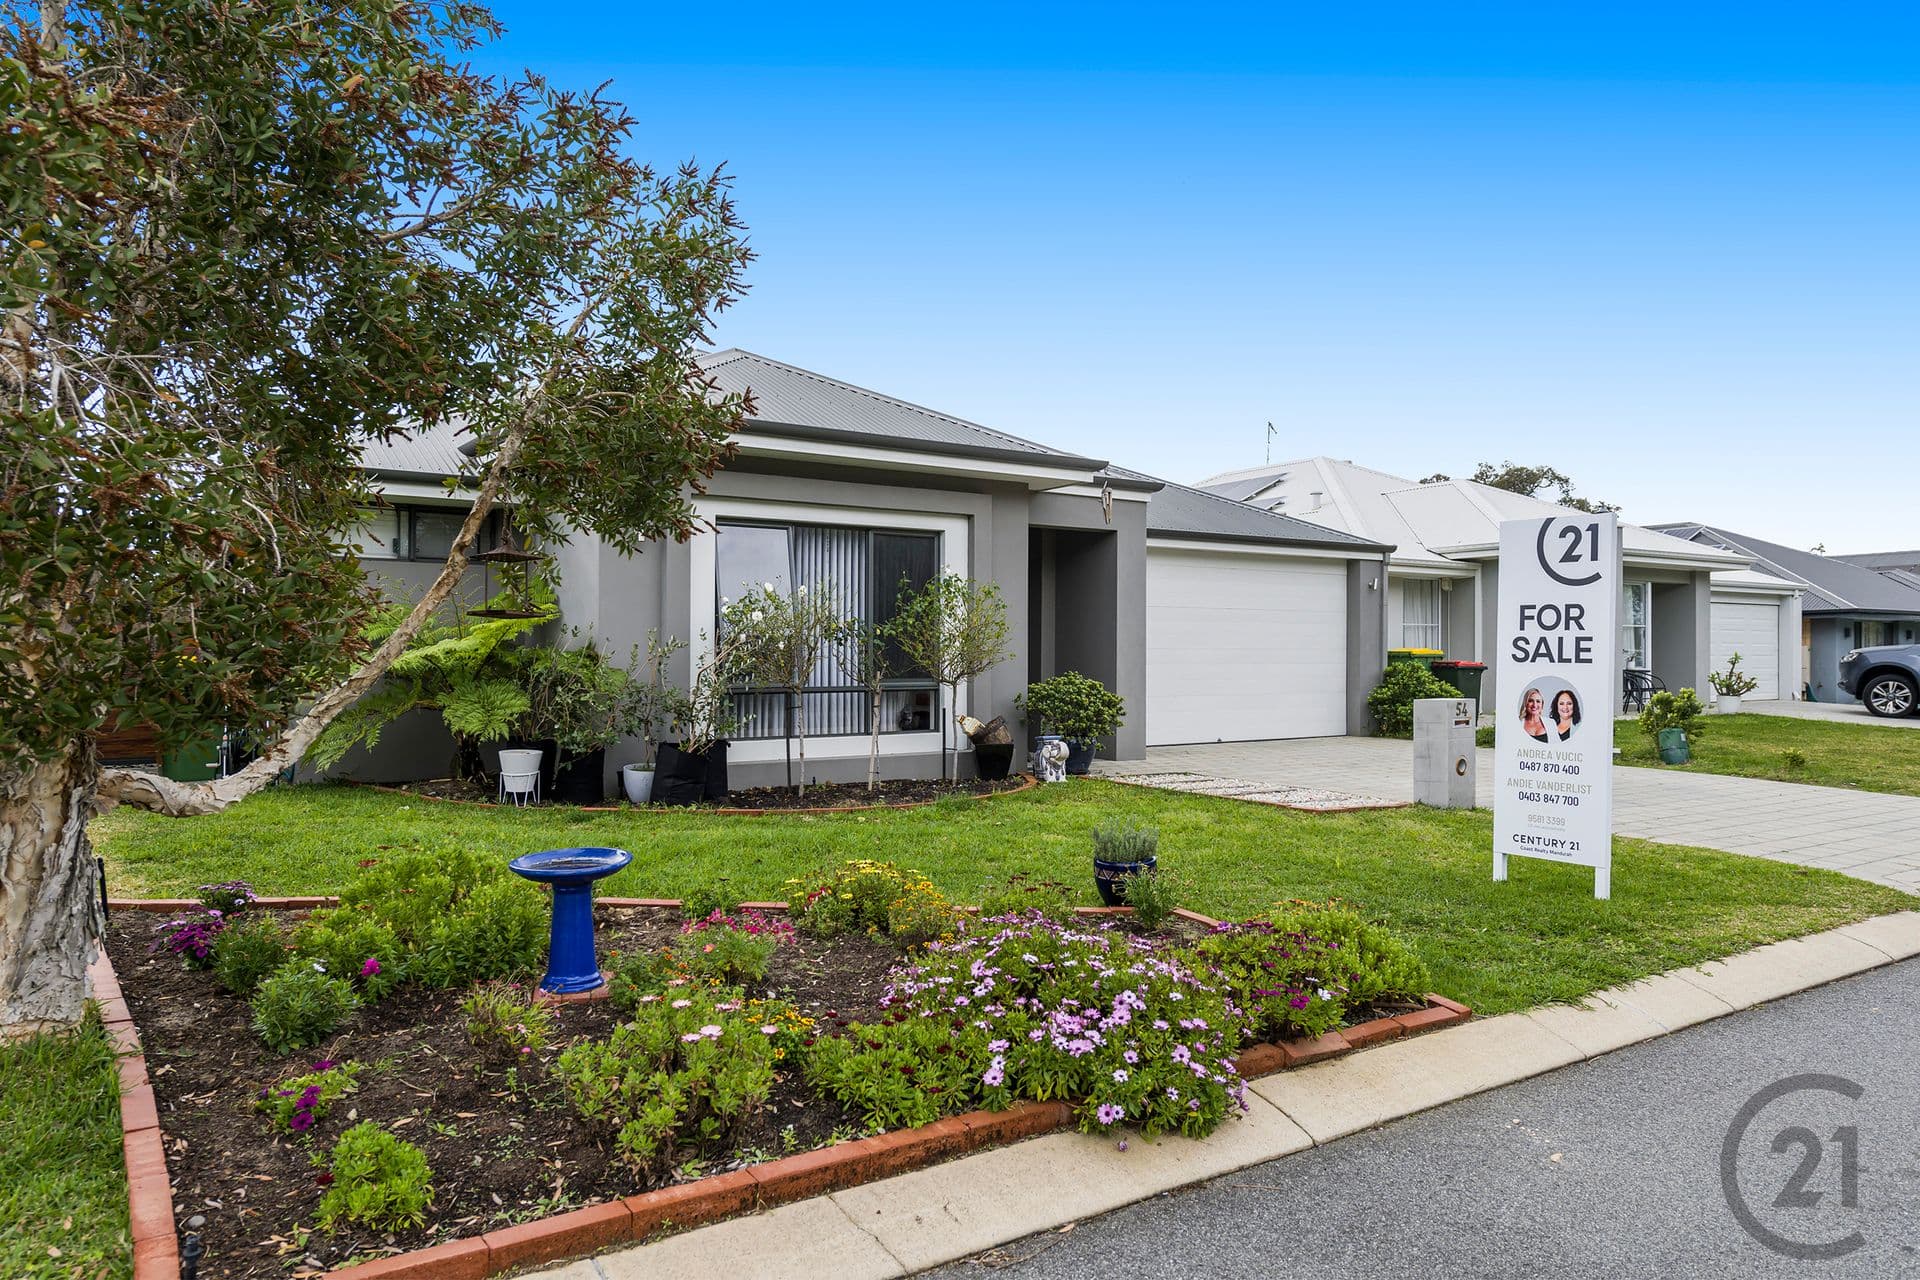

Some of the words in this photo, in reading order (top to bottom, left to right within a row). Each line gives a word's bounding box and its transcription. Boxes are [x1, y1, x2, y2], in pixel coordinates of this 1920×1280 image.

[1519, 603, 1585, 631] FOR
[1511, 636, 1593, 663] SALE
[1455, 702, 1469, 716] 54
[1516, 748, 1553, 760] ANDREA
[1555, 751, 1584, 762] VUCIC
[1519, 761, 1541, 771] 0487
[1543, 763, 1560, 773] 870
[1562, 765, 1580, 775] 400
[1507, 778, 1534, 789] ANDIE
[1536, 780, 1592, 794] VANDERLIST
[1518, 791, 1541, 802] 0403
[1543, 793, 1560, 804] 847
[1562, 796, 1579, 806] 700
[1512, 834, 1566, 848] CENTURY
[1569, 841, 1580, 851] 21
